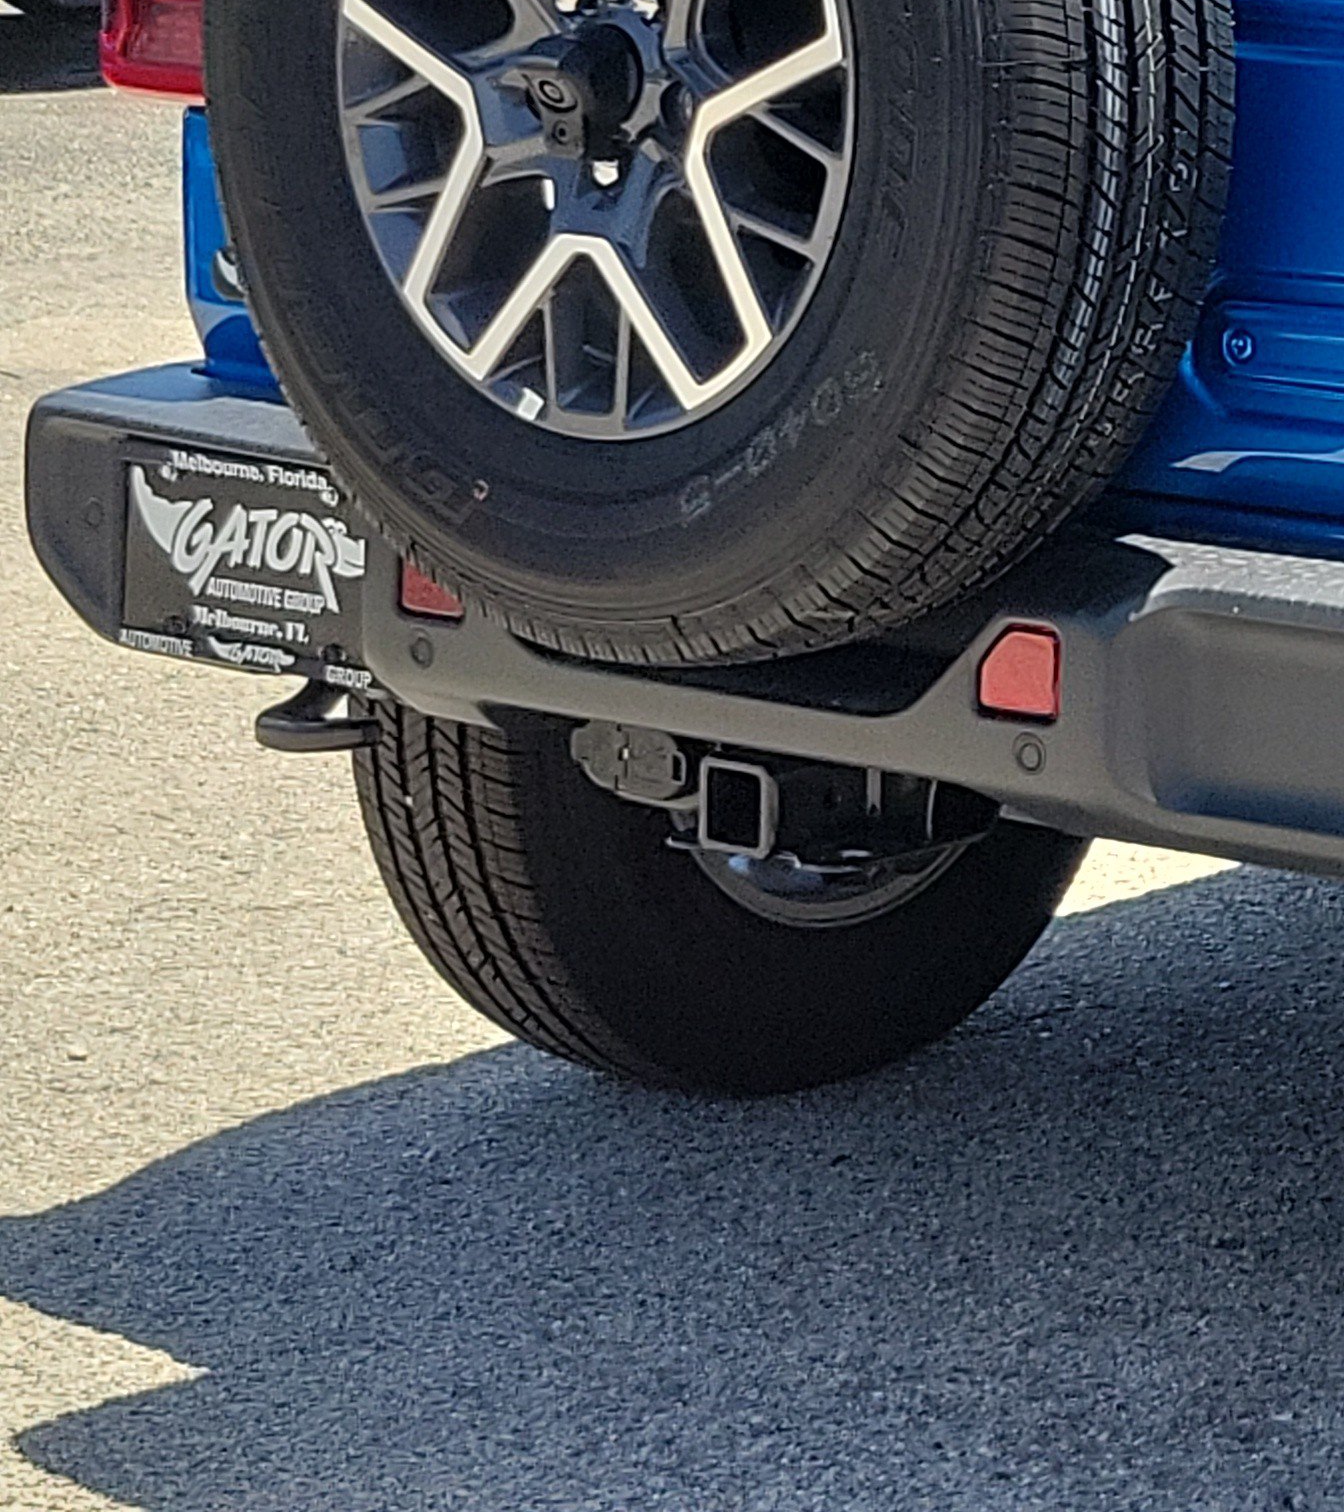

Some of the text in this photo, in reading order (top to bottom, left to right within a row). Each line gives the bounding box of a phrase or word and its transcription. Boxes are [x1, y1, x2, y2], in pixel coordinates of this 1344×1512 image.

[172, 497, 341, 615] GATOR
[205, 576, 327, 616] AUTOMOTIVE GROUP
[118, 627, 195, 658] AUTOMOTIVE
[226, 642, 284, 674] GATOR
[324, 663, 374, 689] GROUP
